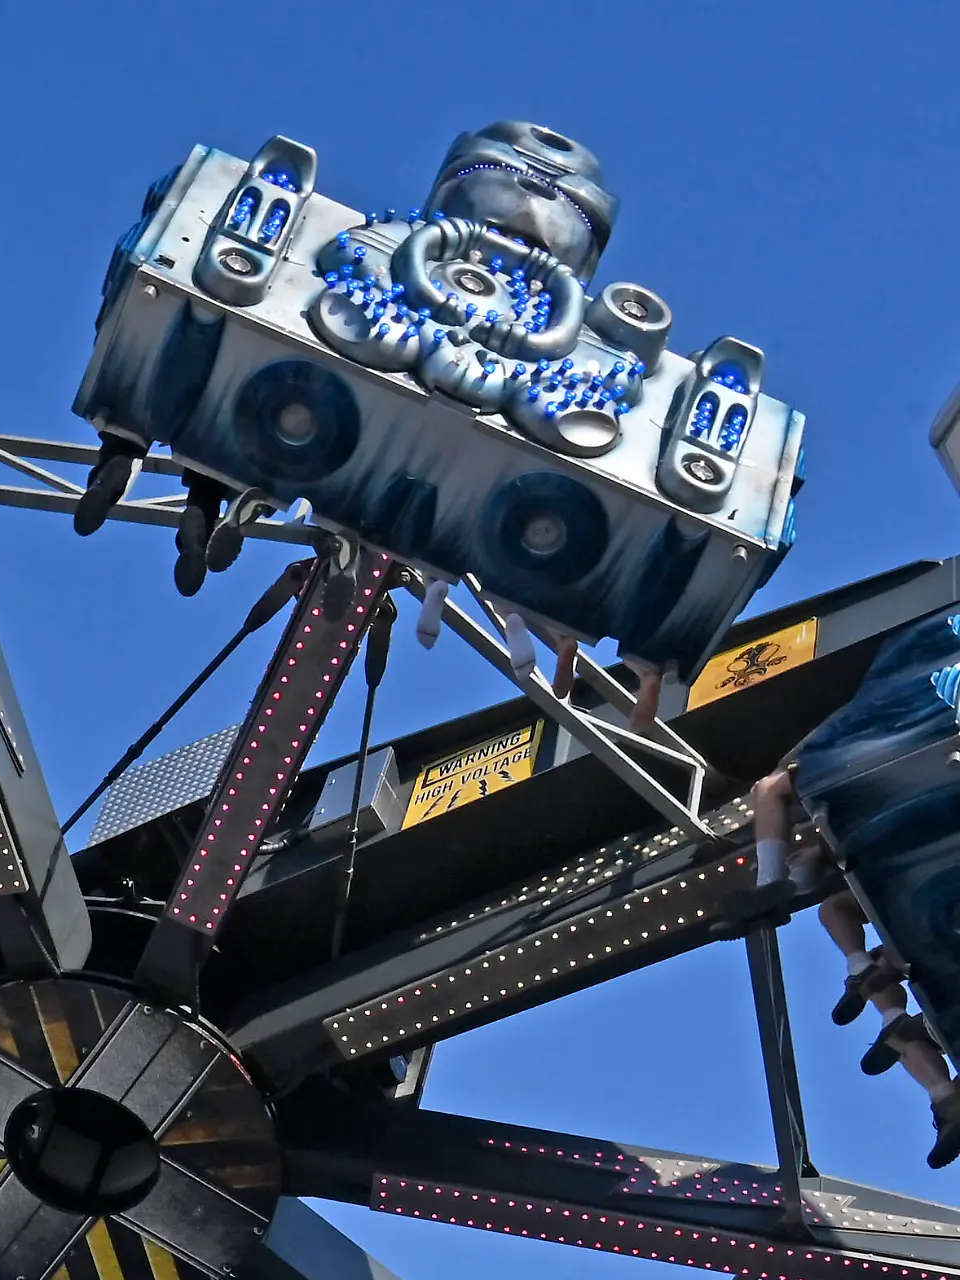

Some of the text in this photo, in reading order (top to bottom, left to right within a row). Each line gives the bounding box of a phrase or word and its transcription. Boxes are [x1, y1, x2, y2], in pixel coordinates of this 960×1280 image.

[414, 747, 532, 805] HIGH VOLTAGE
[438, 732, 522, 777] WARNING
